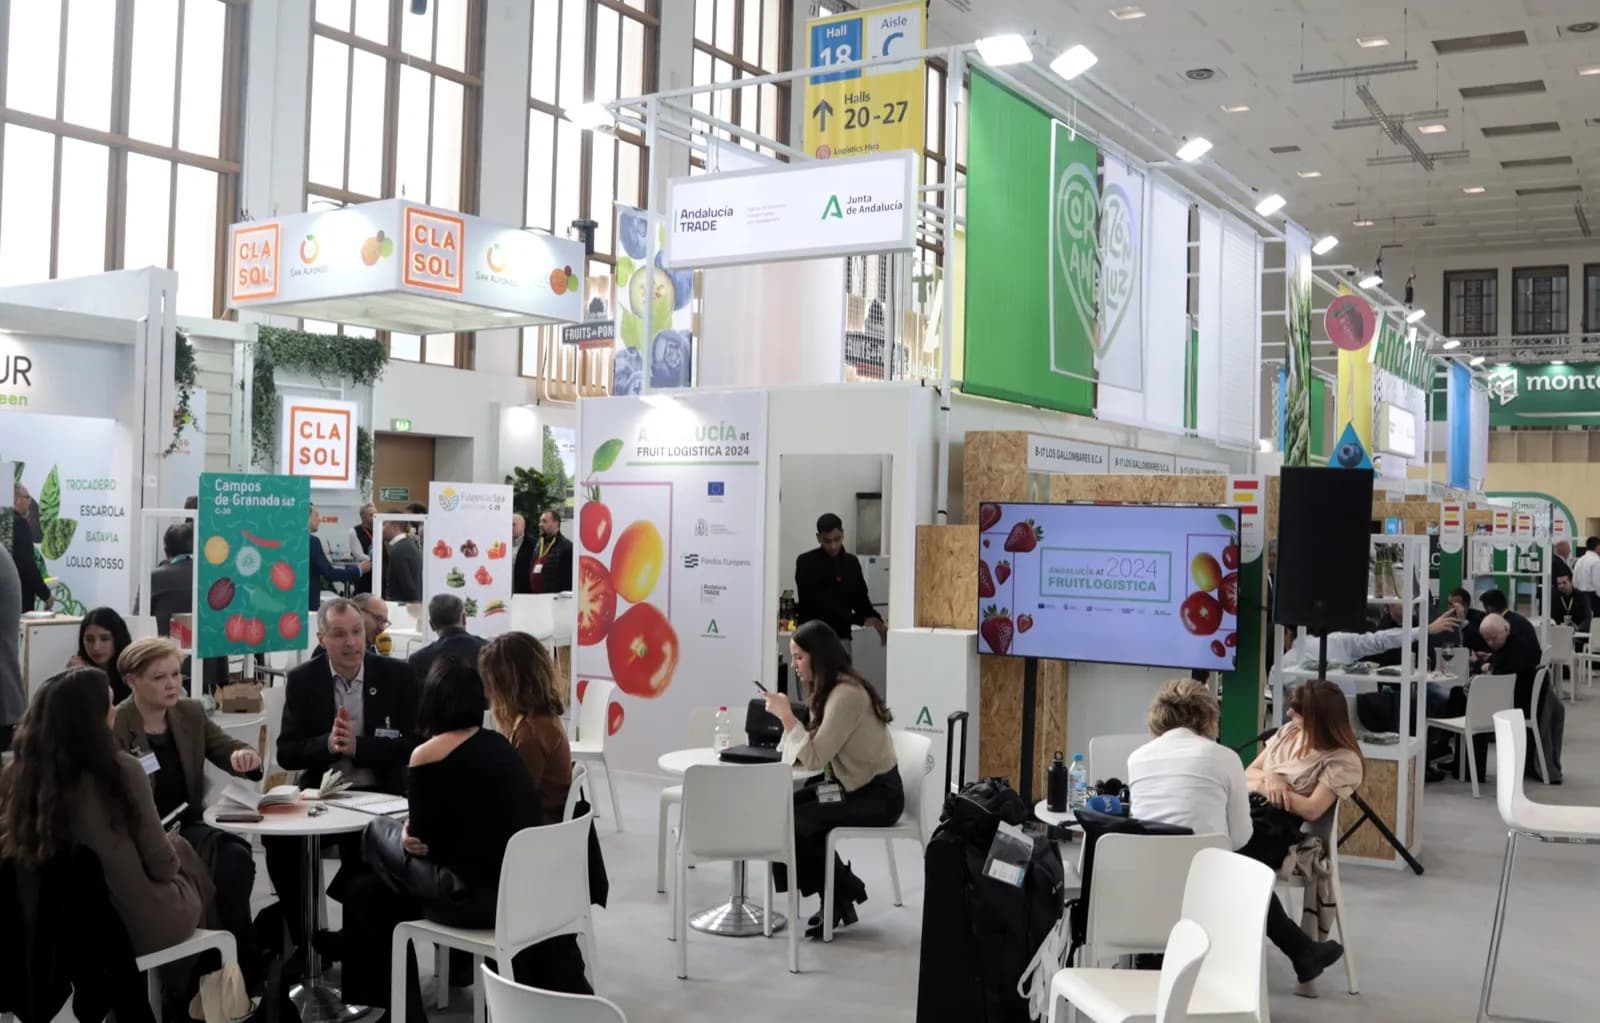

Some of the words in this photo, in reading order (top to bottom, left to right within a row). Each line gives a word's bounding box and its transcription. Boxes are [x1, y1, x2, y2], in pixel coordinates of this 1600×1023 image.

[881, 16, 908, 29] Aisle
[826, 24, 847, 38] Hall
[844, 92, 871, 105] Halls
[834, 145, 863, 156] Logistics
[847, 194, 872, 205] Junta
[680, 205, 734, 220] Andalucía
[846, 205, 857, 216] de
[859, 201, 903, 214] Andalucía
[680, 221, 717, 233] TRADE
[414, 224, 455, 249] CLA
[239, 239, 272, 260] CLA
[414, 253, 454, 278] SOL
[239, 266, 271, 286] SOL
[564, 327, 591, 340] FRUITS
[598, 325, 614, 337] PON
[300, 421, 341, 440] CLA
[638, 421, 737, 442] AUCÍA
[740, 431, 749, 441] at
[300, 447, 340, 466] SOL
[637, 447, 665, 457] FRUIT
[668, 446, 722, 457] LOGISTICA
[725, 446, 749, 456] 2024
[1046, 448, 1056, 459] LOS
[66, 478, 117, 491] TROCADERO
[215, 478, 261, 495] Campos
[215, 492, 229, 505] de
[233, 493, 280, 506] Granada
[80, 504, 125, 518] ESCAROLA
[85, 531, 119, 543] BATAVIA
[66, 555, 93, 568] LOLLO
[94, 556, 125, 570] ROSSO
[1095, 568, 1104, 576] AT
[1106, 557, 1157, 579] 2024
[1048, 577, 1157, 592] FRUITLOGISTICA
